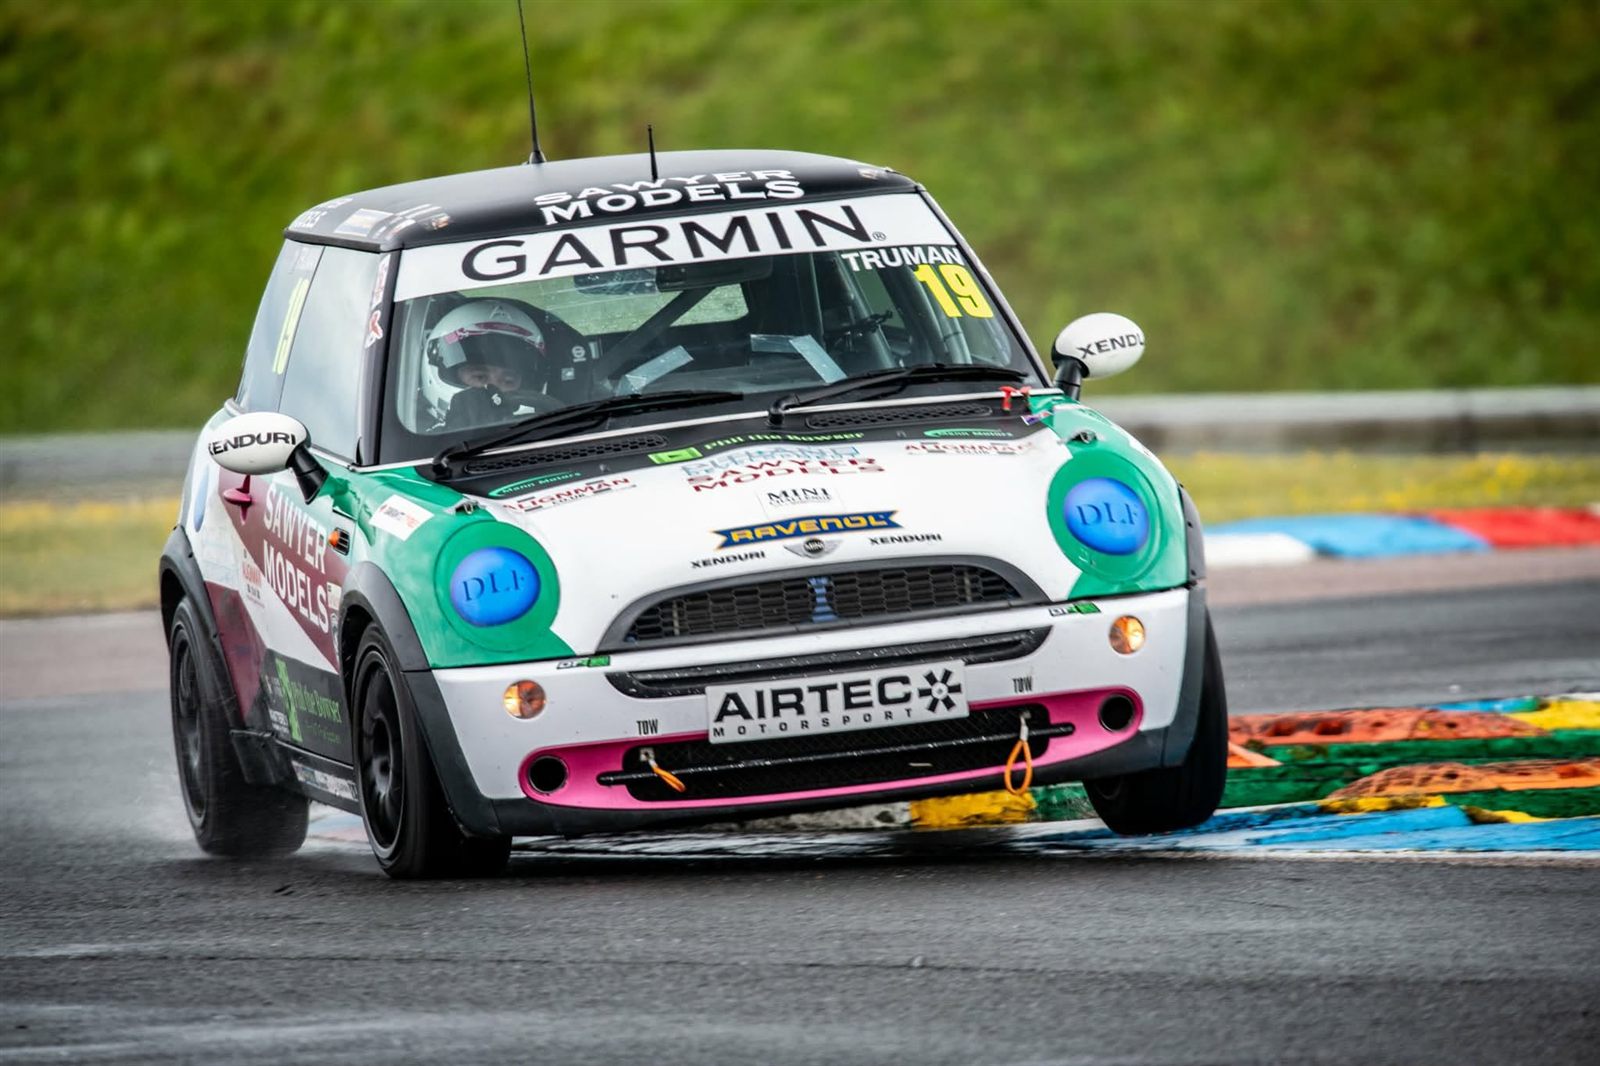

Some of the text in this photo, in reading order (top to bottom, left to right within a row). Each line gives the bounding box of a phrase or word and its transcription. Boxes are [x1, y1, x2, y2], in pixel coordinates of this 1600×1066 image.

[534, 169, 796, 206] SAWYER
[539, 180, 804, 226] MODELS
[461, 205, 872, 282] GARMIN
[841, 245, 965, 271] TRUMAN
[913, 264, 994, 319] 19
[692, 466, 886, 492] MODELS
[767, 488, 828, 500] MINI
[263, 483, 327, 575] SAWYER
[731, 515, 887, 541] RAVENOL
[870, 533, 942, 545] XENDURI
[691, 550, 766, 569] XENDURI
[263, 539, 329, 634] MODELS
[713, 674, 912, 723] AIRTEC
[712, 708, 914, 738] MOTORSPORT
